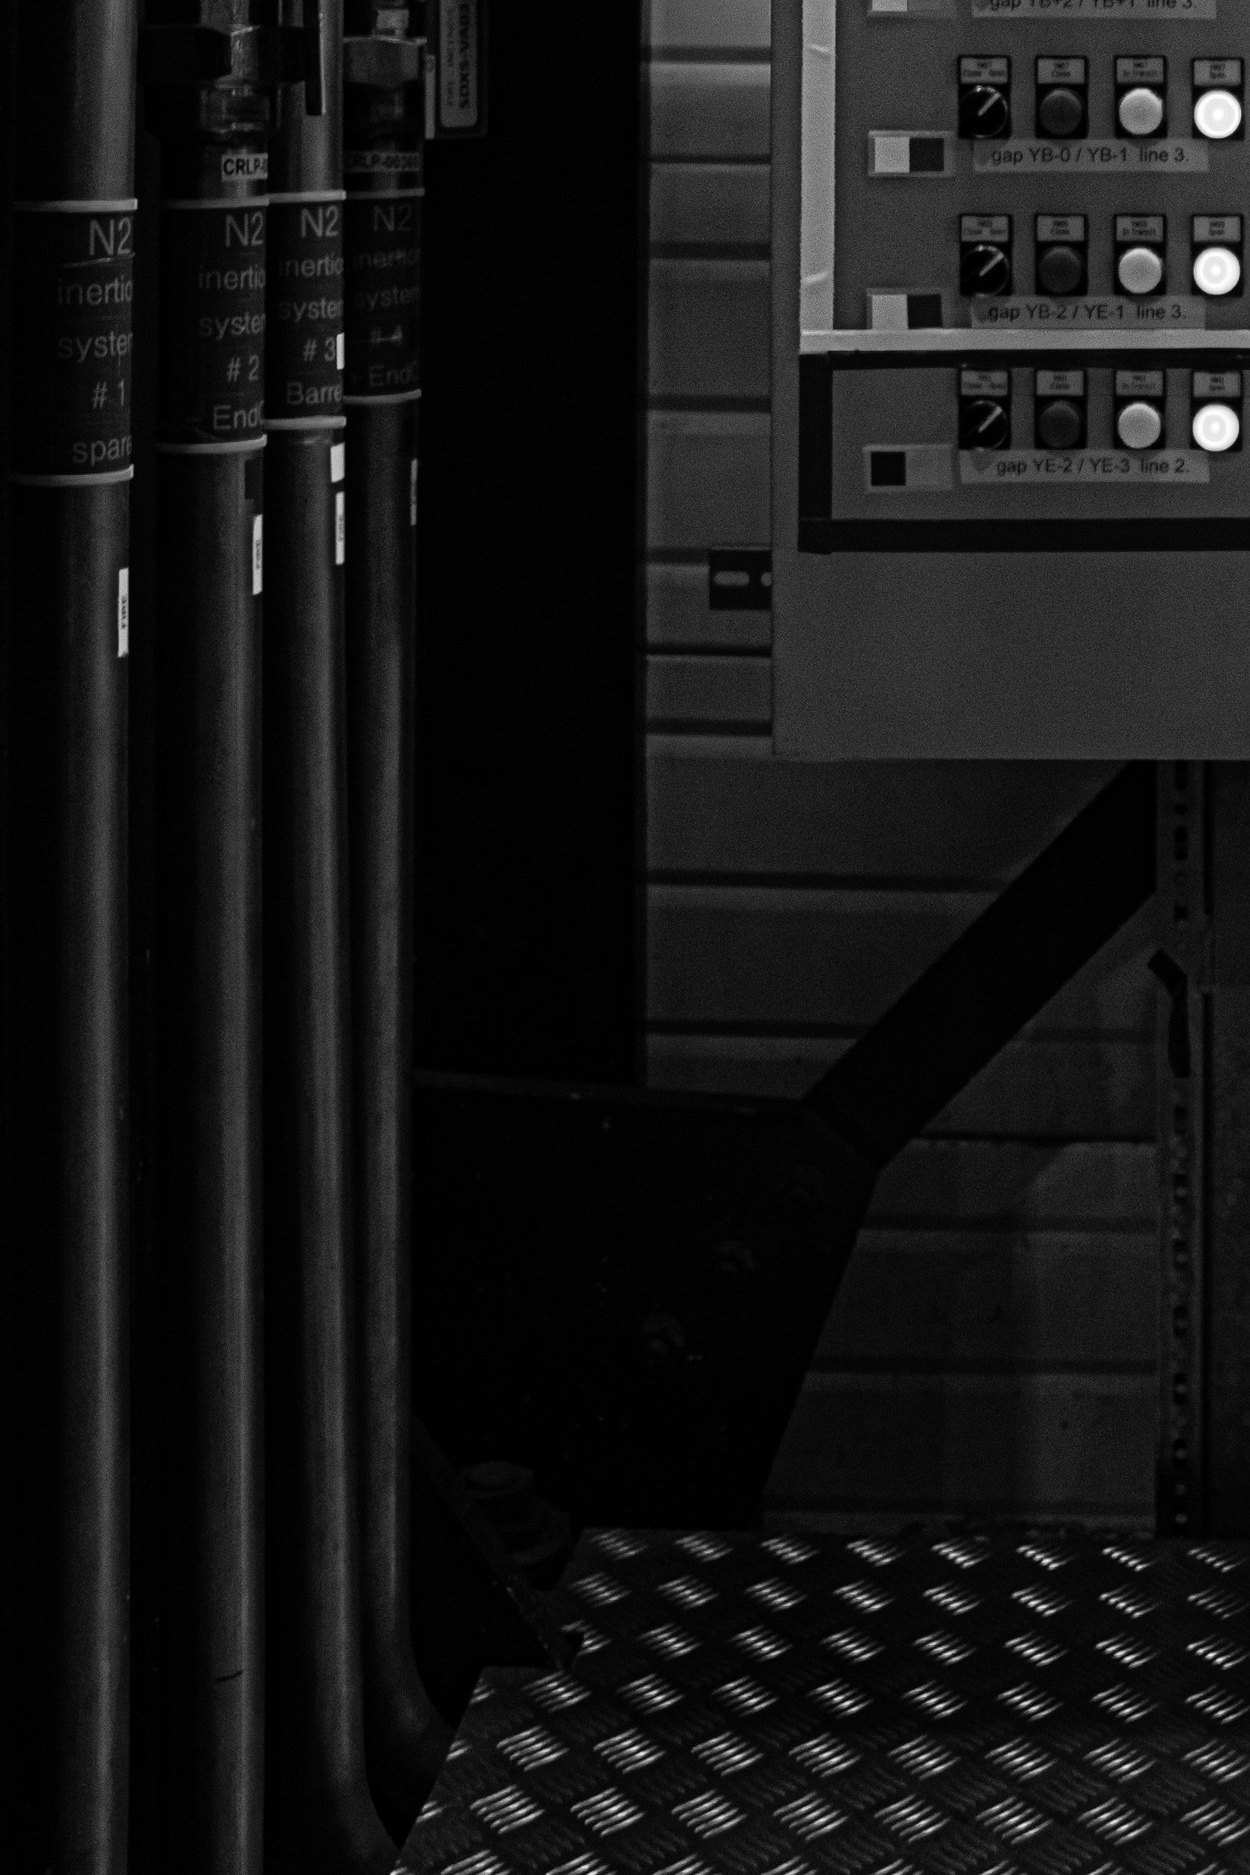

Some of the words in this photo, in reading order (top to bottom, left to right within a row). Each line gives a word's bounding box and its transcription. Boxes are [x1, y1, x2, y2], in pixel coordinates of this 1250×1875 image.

[991, 150, 1024, 166] gap
[1028, 147, 1071, 163] YB-0
[1075, 147, 1082, 163] /
[1087, 147, 1127, 163] YB-1
[1139, 147, 1169, 163] line
[224, 212, 265, 248] N2
[300, 205, 340, 239] N2
[374, 204, 413, 234] N2
[89, 217, 133, 257] N2
[988, 305, 1021, 322] gap
[1025, 303, 1067, 320] YB-2
[1072, 303, 1080, 320] /
[1084, 303, 1124, 320] YE-1
[1136, 304, 1166, 319] line
[303, 338, 317, 361] #
[324, 336, 337, 362] 3
[226, 357, 241, 383] #
[248, 354, 260, 382] 2
[92, 382, 108, 409] #
[117, 379, 126, 406] 1
[997, 460, 1028, 477] gap
[1032, 458, 1073, 474] YE-2
[1078, 458, 1085, 474] /
[1089, 458, 1130, 474] YE-3
[1139, 458, 1170, 474] line
